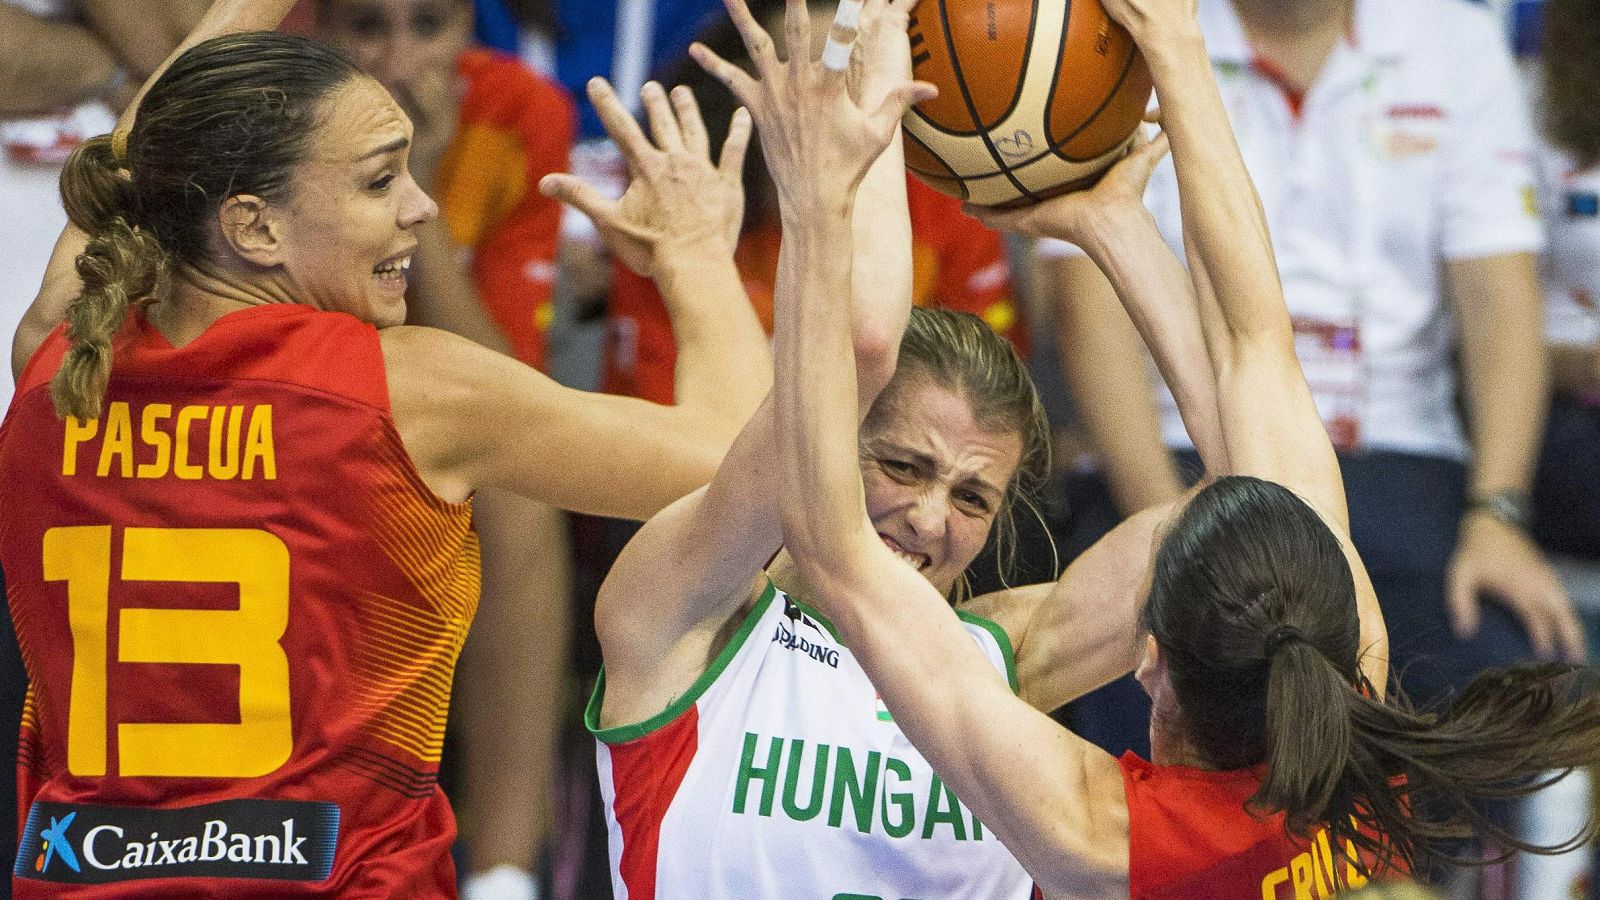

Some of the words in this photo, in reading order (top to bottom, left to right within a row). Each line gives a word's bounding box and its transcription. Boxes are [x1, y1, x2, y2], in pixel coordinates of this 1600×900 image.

[62, 401, 277, 480] PASCUA
[42, 525, 293, 778] 13
[732, 732, 983, 841] HUNGA
[82, 818, 308, 870] CaixaBank
